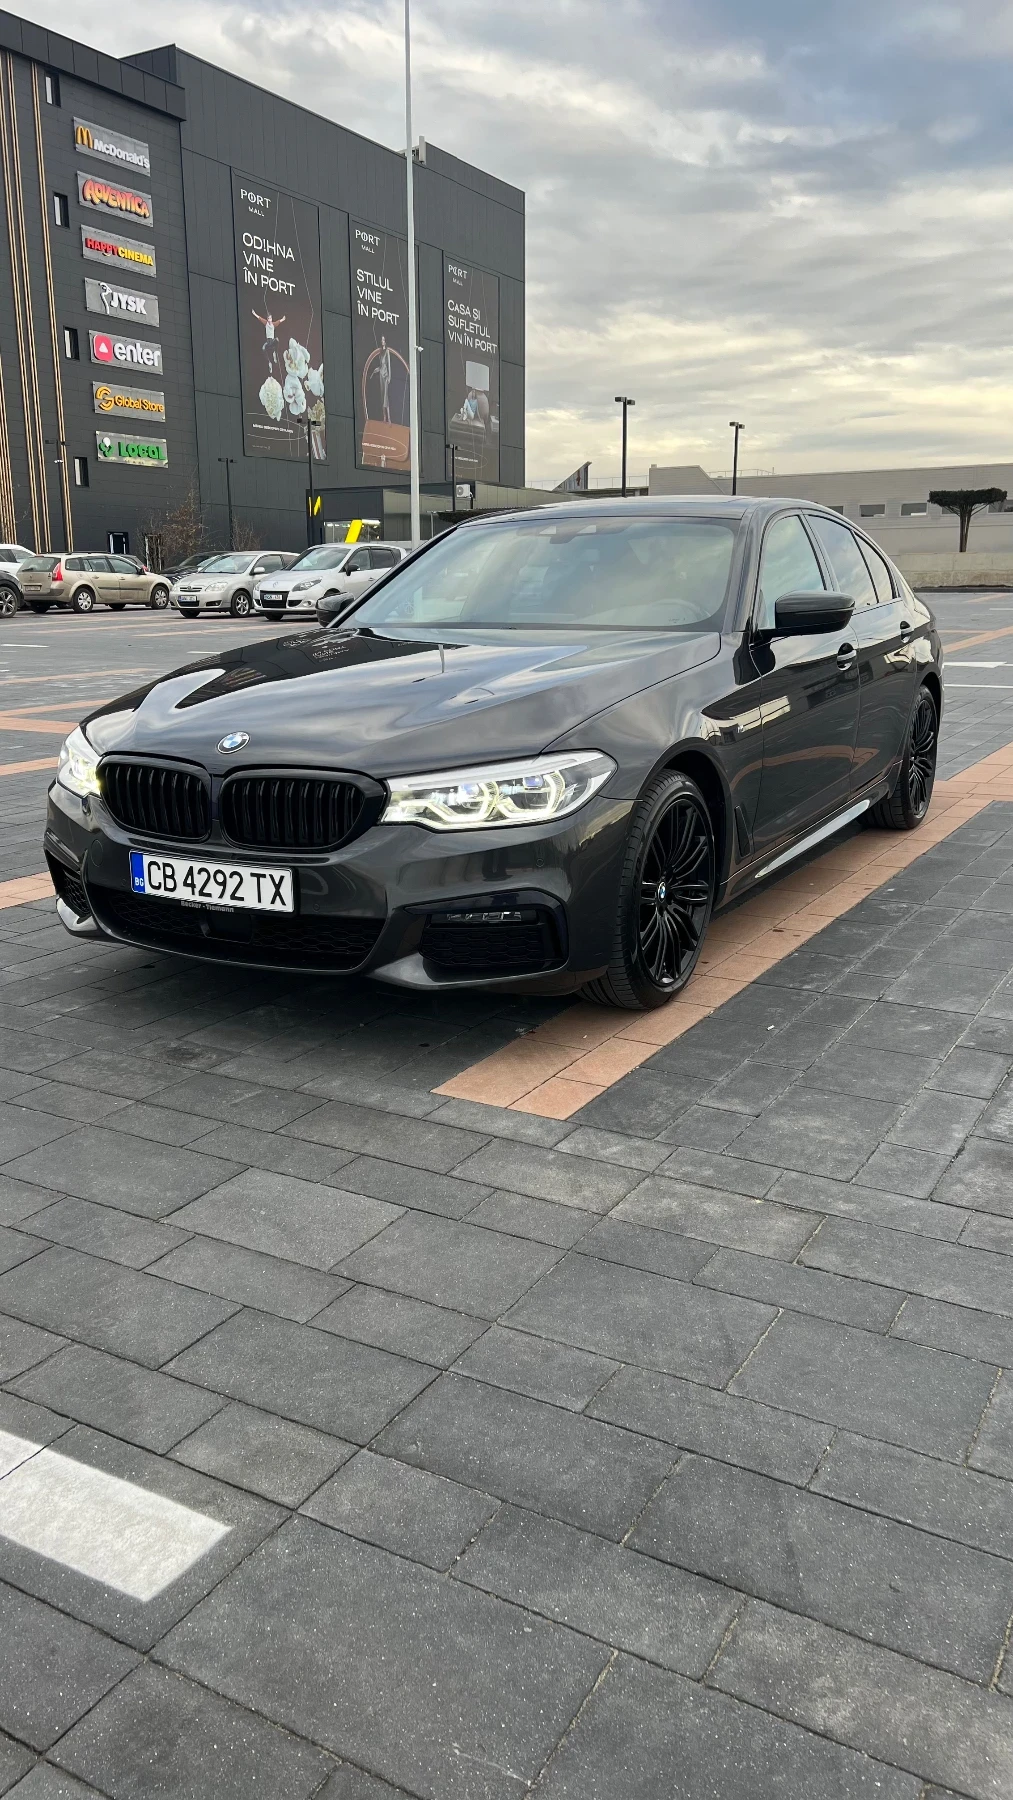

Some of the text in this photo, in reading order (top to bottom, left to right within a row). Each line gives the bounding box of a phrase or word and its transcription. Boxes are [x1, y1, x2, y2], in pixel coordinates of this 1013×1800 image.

[94, 138, 151, 169] McDonald's
[83, 178, 151, 218] ADVENTICA
[240, 188, 272, 209] PORT
[248, 206, 265, 217] MALL
[355, 229, 381, 247] PORT
[242, 250, 274, 272] VINE
[243, 267, 296, 296] ÎN PORT
[356, 268, 394, 292] STILUL
[110, 291, 148, 315] JYSK
[356, 285, 383, 305] VINE
[357, 300, 400, 326] ÎN PORT
[447, 299, 472, 318] CASA
[447, 314, 491, 339] SUFLETUL
[447, 329, 498, 354] VIN ÎN PORT
[113, 341, 161, 368] enter
[114, 394, 165, 413] Global Store
[134, 876, 145, 887] BG
[147, 860, 287, 906] CB 4292 TX
